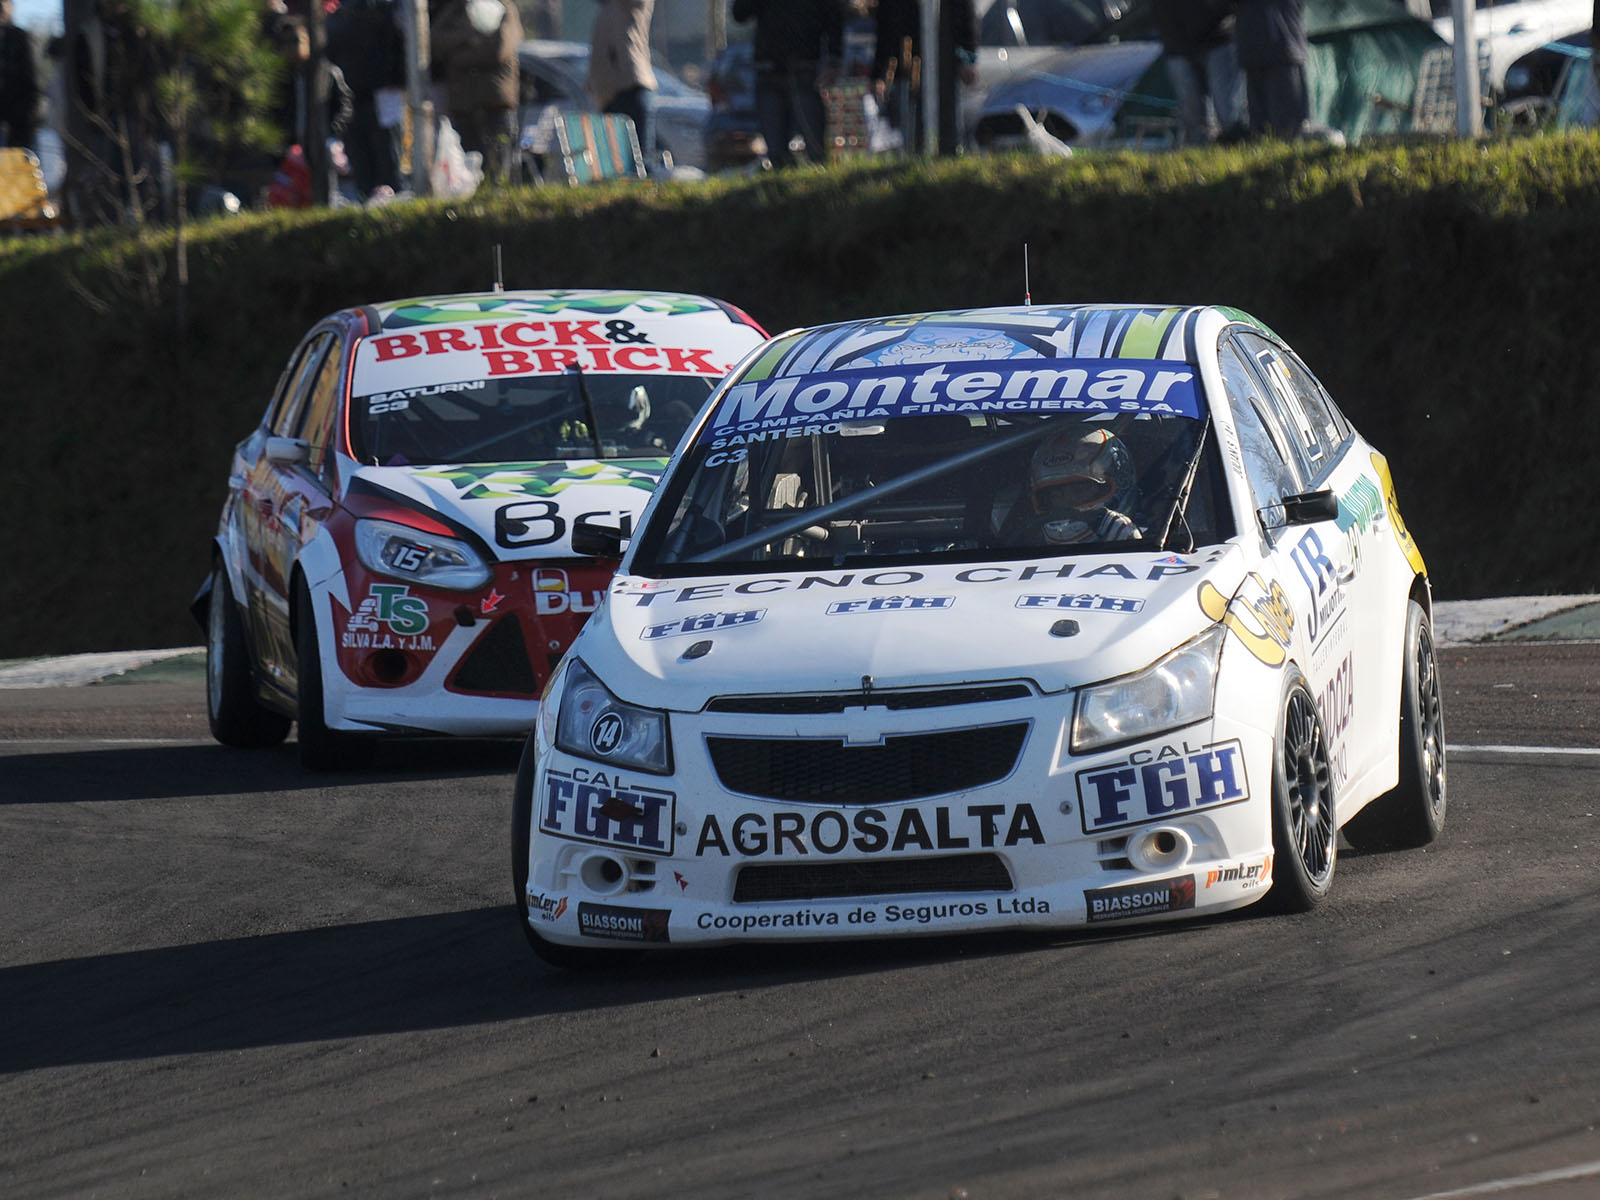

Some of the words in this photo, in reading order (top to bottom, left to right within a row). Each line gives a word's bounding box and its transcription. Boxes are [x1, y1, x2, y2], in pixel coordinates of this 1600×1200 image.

[481, 347, 724, 376] BRICK
[369, 380, 486, 404] SATURNI
[713, 364, 1194, 428] Montemar
[368, 400, 409, 414] C3
[714, 407, 890, 437] COMPAÑIA
[901, 400, 1108, 415] FINANCIERA
[1119, 401, 1184, 414] S.A.
[711, 422, 840, 450] SANTERO
[704, 448, 749, 468] C3
[393, 546, 426, 571] 15
[626, 571, 924, 607] TECNO
[955, 563, 1201, 583] CHAP
[829, 597, 953, 614] FGH
[1018, 595, 1143, 613] FGH
[643, 609, 763, 639] FGH
[342, 632, 370, 648] SILVA
[596, 721, 618, 748] 14
[1128, 741, 1202, 767] CAL
[572, 767, 630, 791] CAL
[1087, 746, 1243, 827] FGH
[543, 777, 668, 849] FGH
[695, 802, 1046, 858] AGROSALTA
[697, 909, 839, 933] Cooperativa
[847, 907, 877, 924] de
[885, 902, 988, 924] Seguros
[996, 897, 1050, 915] Ltda
[1092, 889, 1170, 915] BIASSONI
[581, 913, 643, 932] BIASSONI
